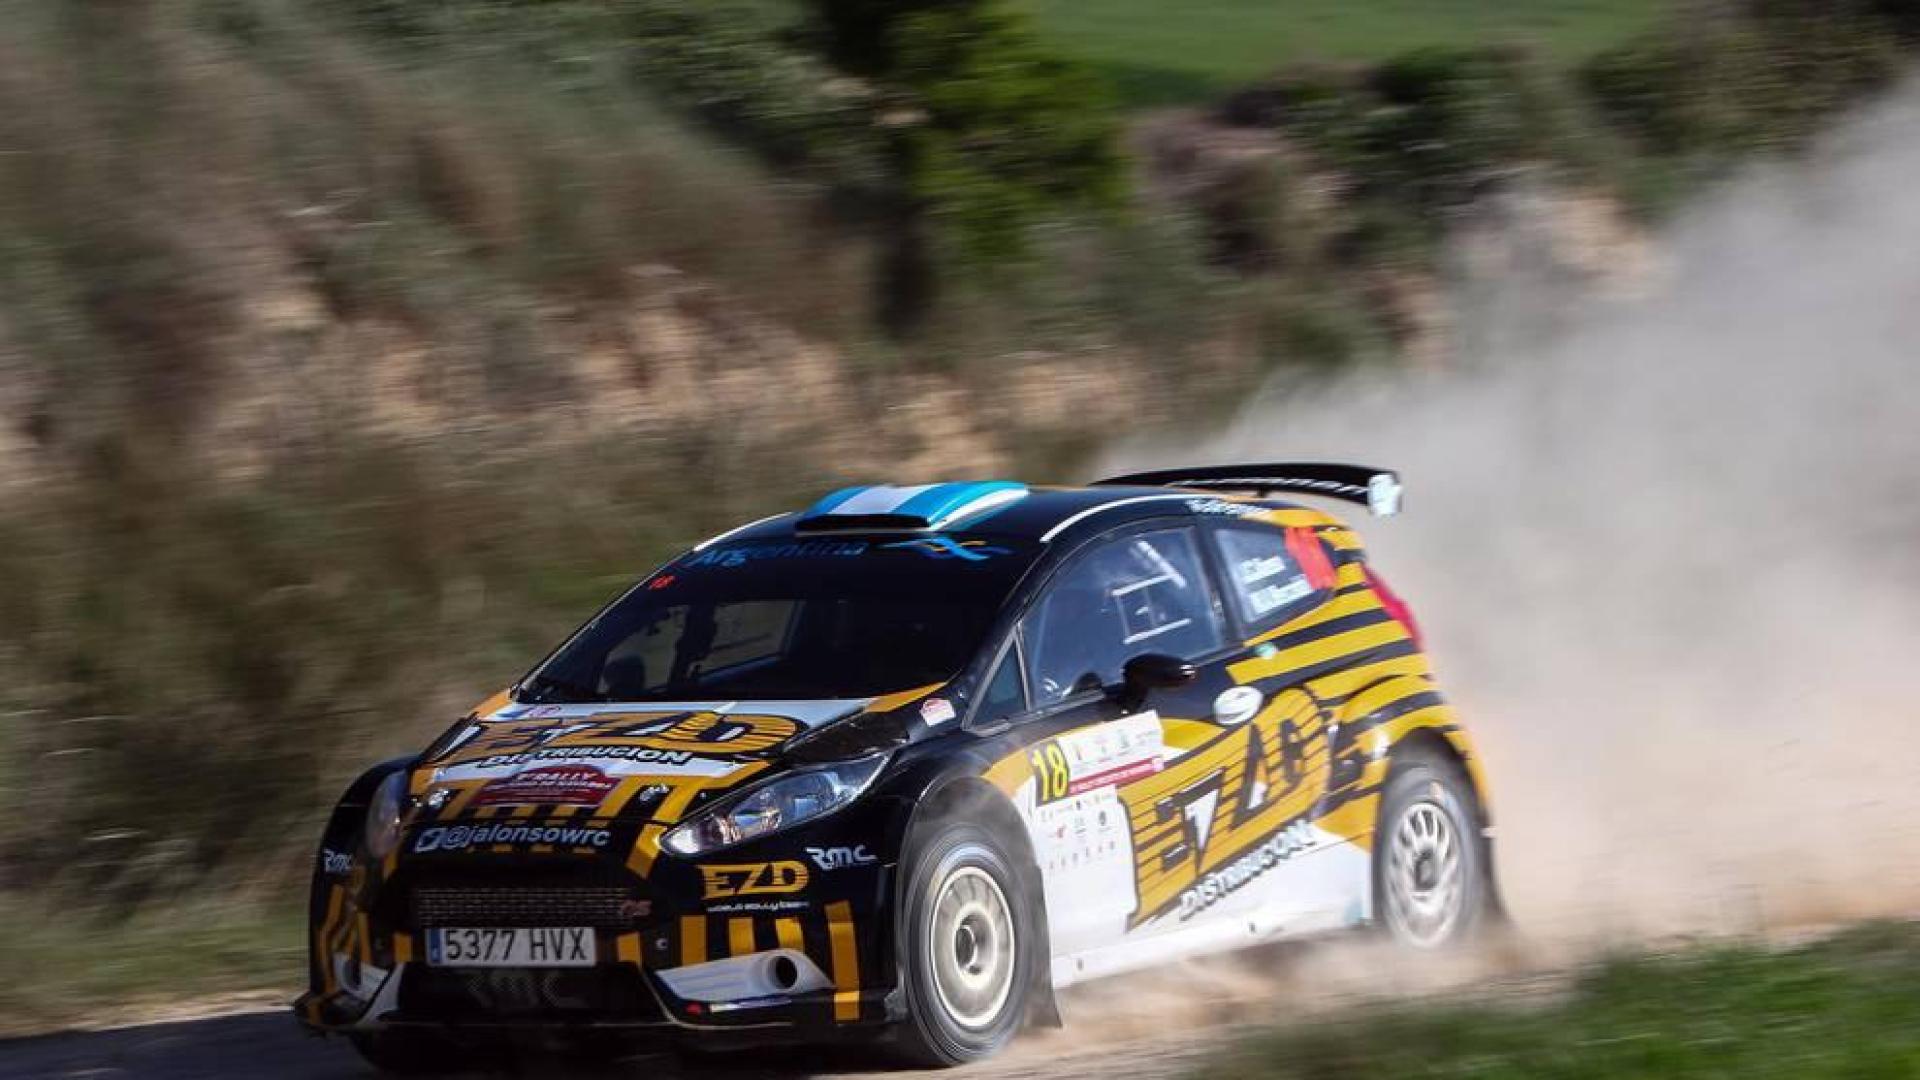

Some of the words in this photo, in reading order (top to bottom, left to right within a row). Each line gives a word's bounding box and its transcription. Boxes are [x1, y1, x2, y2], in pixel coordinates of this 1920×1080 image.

[448, 711, 802, 765] EZD
[1033, 743, 1068, 802] 18
[447, 823, 611, 848] @jalonsowrc
[698, 860, 809, 899] EZD
[445, 930, 516, 961] 5377
[528, 928, 587, 960] HVX
